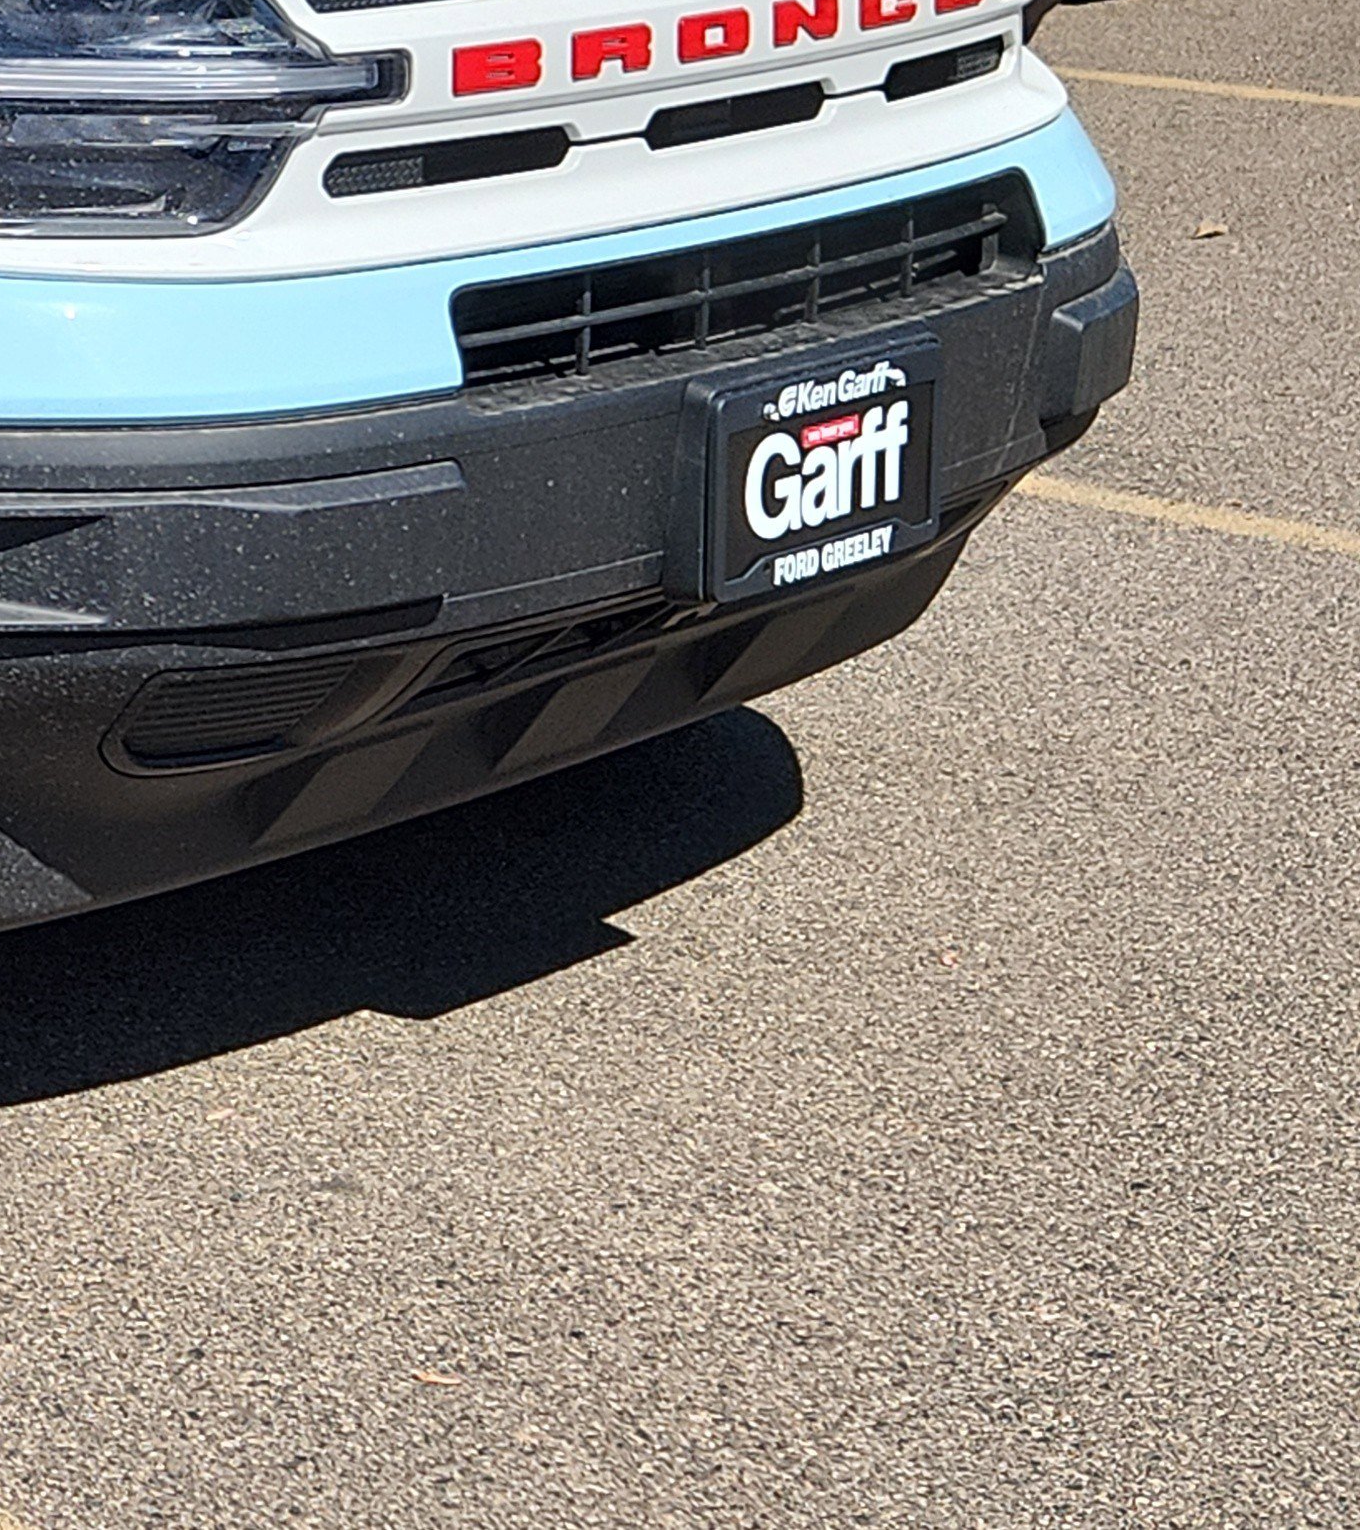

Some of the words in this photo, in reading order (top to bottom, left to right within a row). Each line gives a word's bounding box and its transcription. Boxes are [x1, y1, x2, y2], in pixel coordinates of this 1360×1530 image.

[796, 380, 837, 414] Ken
[838, 361, 890, 402] Garff
[745, 400, 909, 540] Garff
[773, 548, 820, 586] FORD
[821, 525, 893, 572] GREELEY
